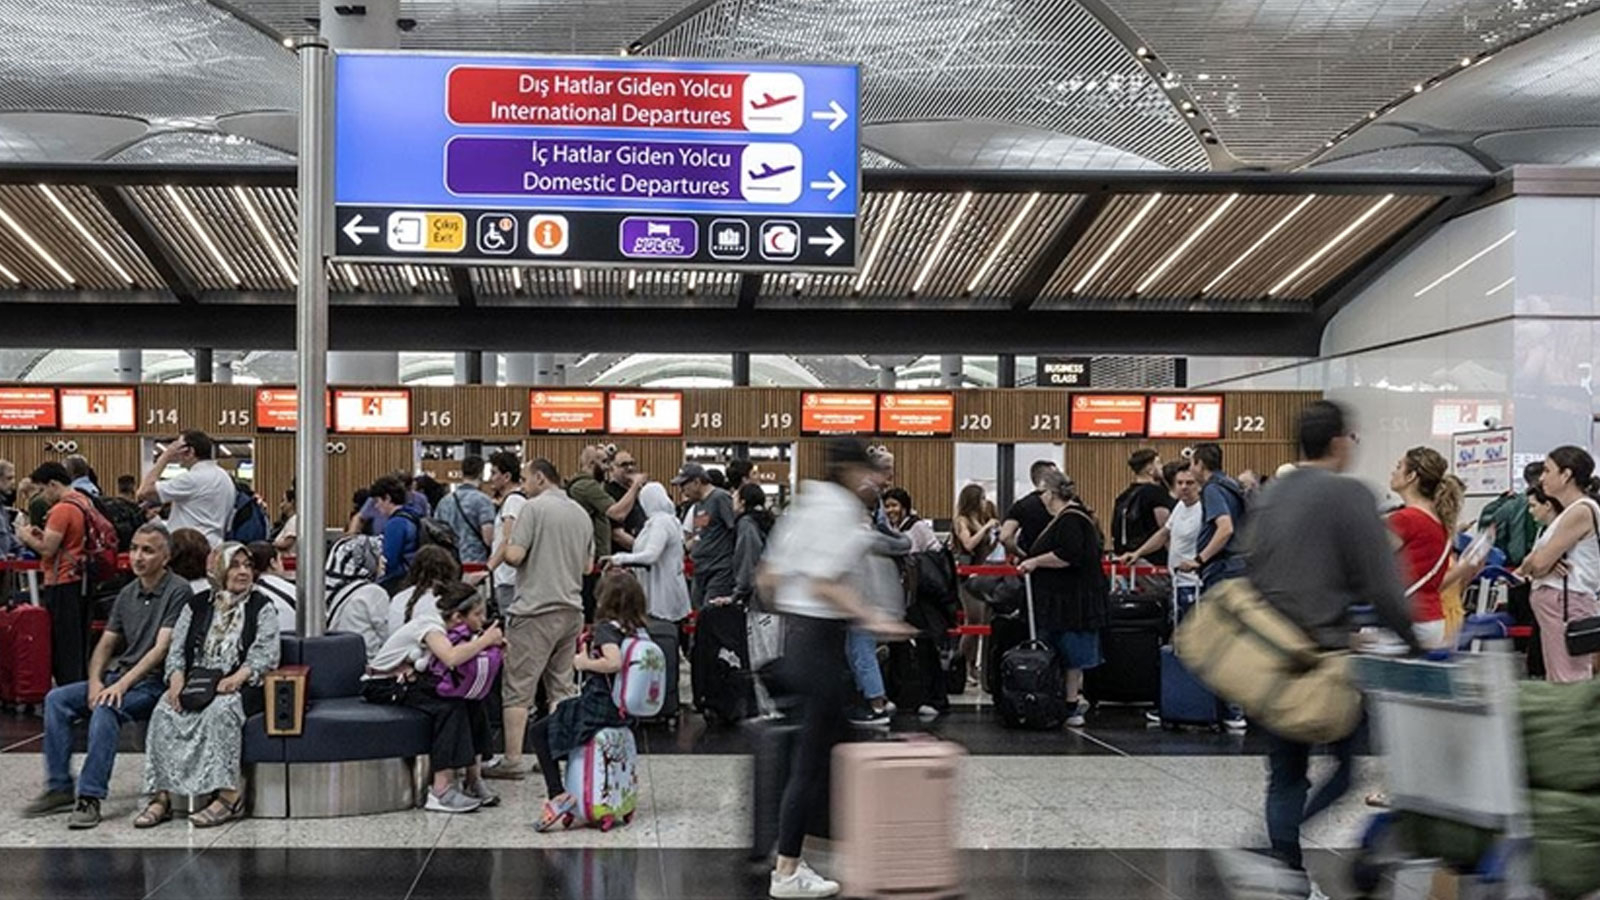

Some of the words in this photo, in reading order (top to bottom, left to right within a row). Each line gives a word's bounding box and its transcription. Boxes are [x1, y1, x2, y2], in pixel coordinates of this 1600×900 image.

[519, 74, 550, 96] Dış
[554, 75, 613, 96] Hatlar
[617, 77, 677, 97] Giden
[681, 78, 733, 98] Yolcu
[490, 101, 618, 123] International
[621, 103, 732, 127] Departures
[531, 141, 548, 166] İç
[553, 144, 612, 165] Hatlar
[616, 146, 675, 166] Giden
[678, 147, 731, 169] Yolcu
[523, 173, 617, 192] Domestic
[623, 176, 730, 197] Departures
[433, 232, 454, 244] Exit
[1044, 363, 1084, 374] BUSINESS
[1050, 374, 1078, 384] CLASS
[147, 409, 178, 424] J14
[218, 410, 250, 425] J15
[420, 411, 451, 426] J16
[490, 412, 521, 427] J17
[692, 412, 723, 428] J18
[761, 413, 792, 428] J19
[960, 414, 992, 430] J20
[1031, 414, 1060, 430] J21
[1233, 416, 1265, 432] J22
